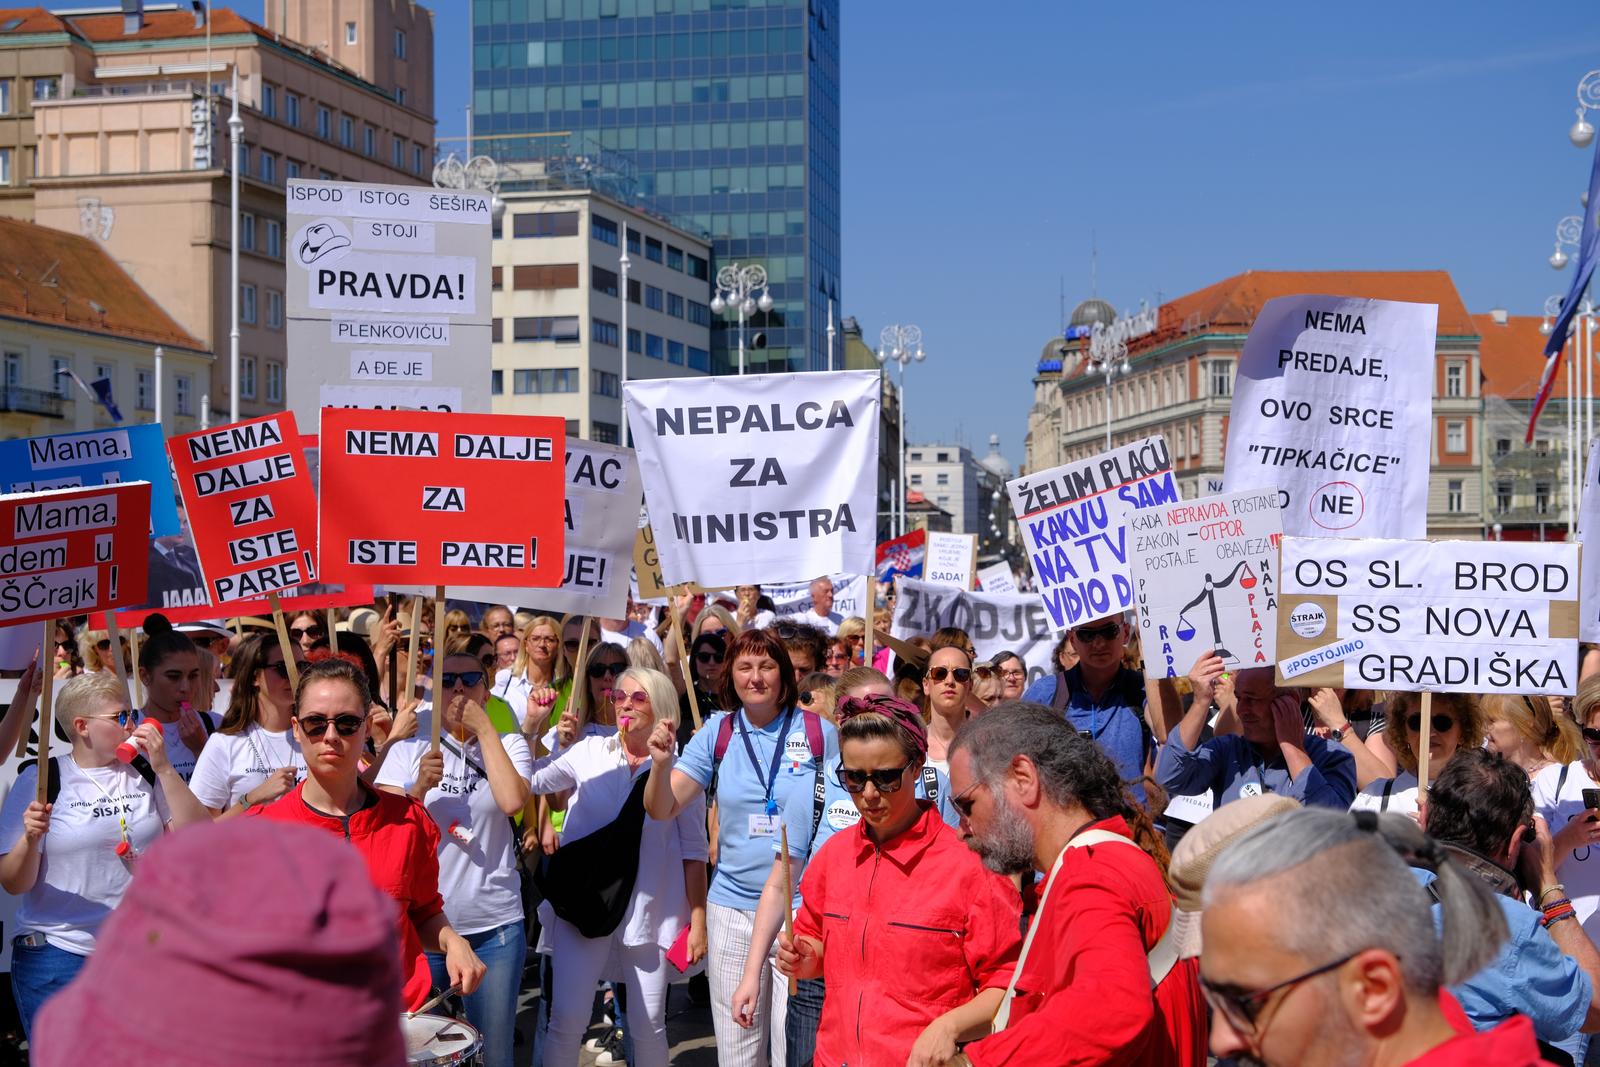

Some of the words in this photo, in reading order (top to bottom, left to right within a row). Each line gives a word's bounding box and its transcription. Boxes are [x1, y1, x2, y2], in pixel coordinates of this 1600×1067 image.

[290, 186, 342, 202] ISPOD
[359, 190, 410, 206] ISTOG
[429, 195, 488, 213] ŠEŠIRA
[371, 222, 417, 238] STOJI
[318, 269, 464, 300] PRAVDA!
[338, 323, 447, 341] PLENKOVIĆU,
[1305, 309, 1366, 335] NEMA
[357, 361, 369, 374] A
[374, 361, 398, 375] ĐE
[403, 362, 423, 375] JE
[1278, 349, 1388, 381] PREDAJE,
[656, 400, 854, 436] NEPALCA
[1260, 398, 1313, 421] OVO
[1329, 405, 1394, 430] SRCE
[31, 432, 129, 465] Mama,
[189, 422, 281, 462] NEMA
[347, 430, 438, 457] NEMA
[455, 434, 552, 461] DALJE
[194, 454, 295, 498] DALJE
[729, 457, 788, 488] ZA
[1018, 466, 1098, 516] ŽELIM
[1100, 438, 1171, 492] PLAĆU
[231, 496, 274, 527] ZA
[422, 486, 465, 511] ZA
[1132, 513, 1163, 532] KADA
[1167, 502, 1228, 526] NEPRAVDA
[1232, 493, 1280, 515] POSTANE
[1321, 494, 1354, 515] NE
[16, 502, 117, 535] Mama,
[1029, 496, 1109, 549] KAKVU
[96, 541, 112, 562] u
[228, 529, 298, 564] ISTE
[349, 540, 416, 564] ISTE
[1033, 545, 1079, 587] NA
[1074, 525, 1127, 573] TV
[1136, 530, 1180, 552] ZAKON
[1145, 548, 1199, 571] POSTAJE
[1295, 558, 1348, 588] OS
[1368, 559, 1423, 589] SL.
[1455, 561, 1569, 593] BROD
[1042, 578, 1110, 628] VIDIO
[1351, 604, 1401, 633] SS
[1426, 607, 1537, 638] NOVA
[1287, 639, 1364, 674] #POSTOJIMO
[1358, 651, 1568, 689] GRADIŠKA
[93, 803, 133, 818] SISAK
